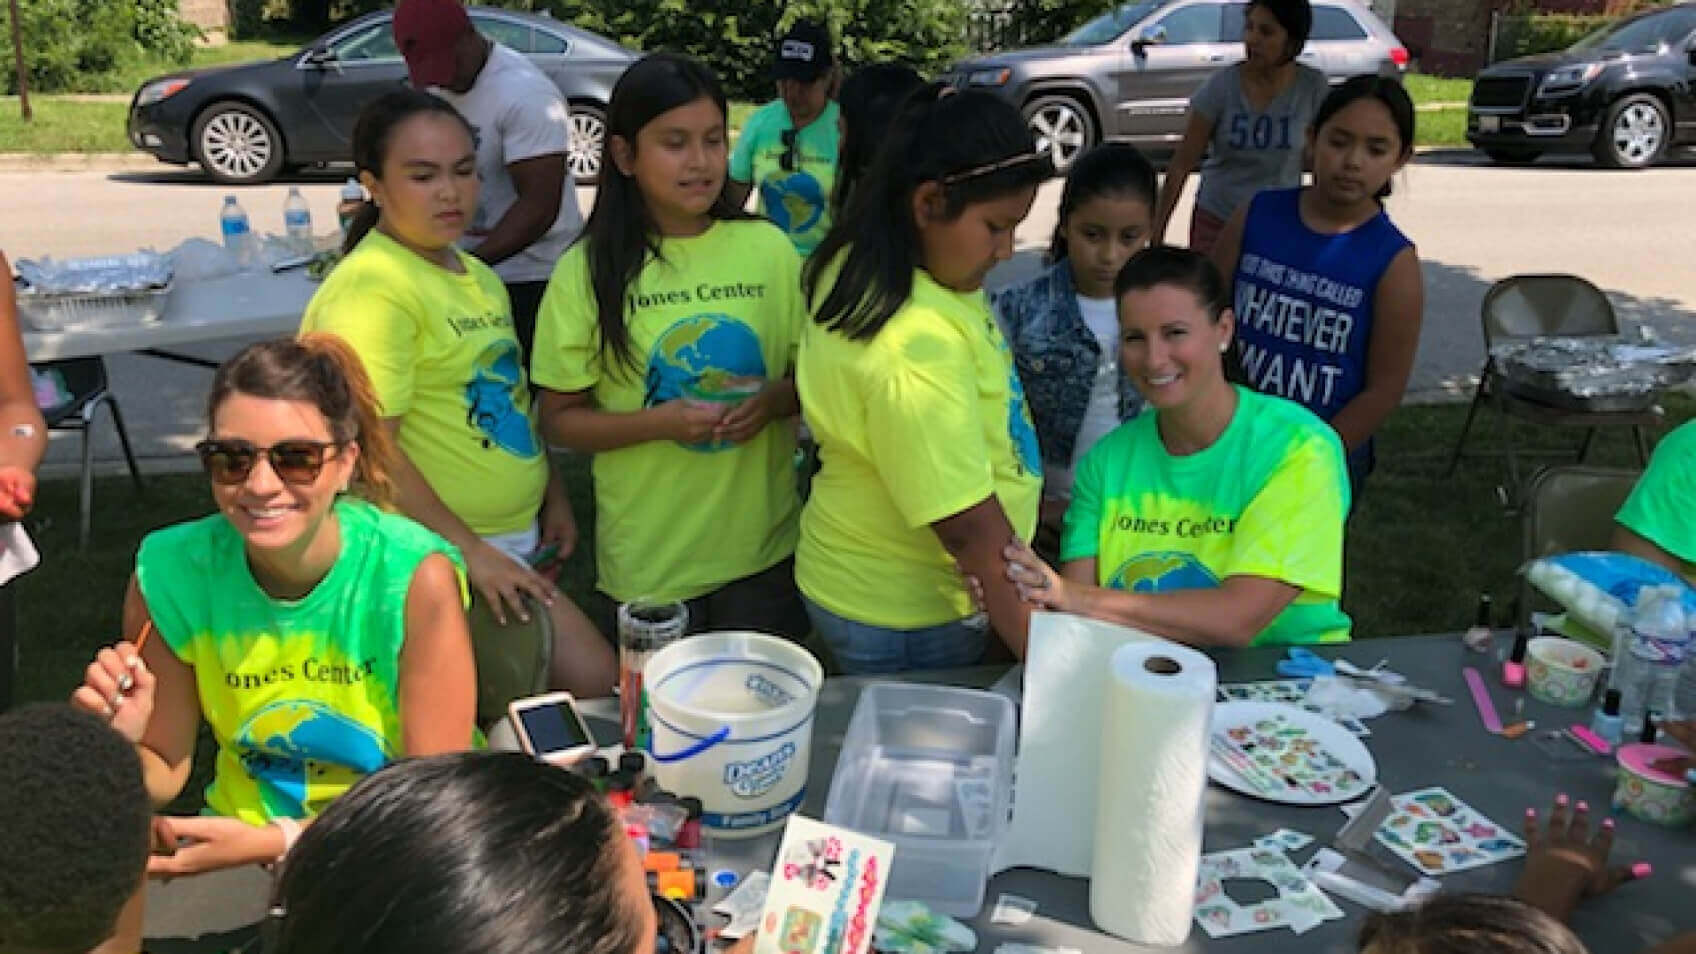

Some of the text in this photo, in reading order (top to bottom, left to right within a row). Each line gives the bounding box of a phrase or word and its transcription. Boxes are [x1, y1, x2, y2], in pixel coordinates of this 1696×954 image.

[1228, 113, 1292, 150] 501
[628, 282, 766, 315] Jones Center
[1177, 516, 1234, 538] Ceter
[226, 664, 295, 690] ones
